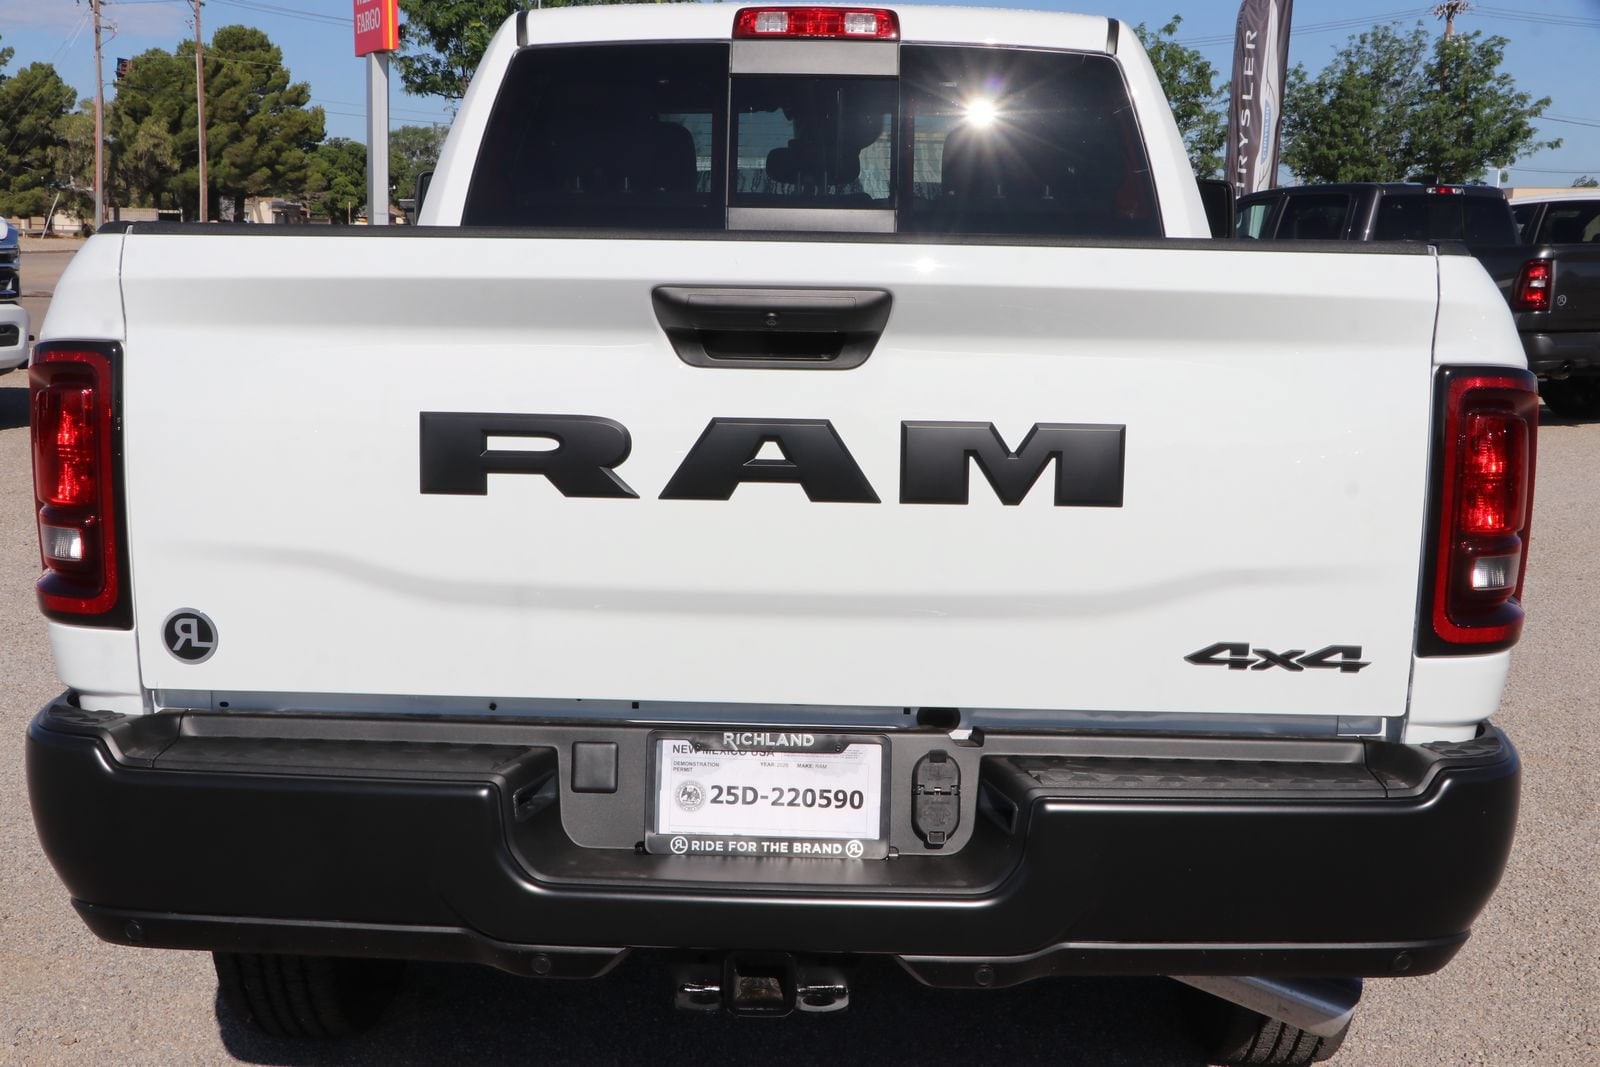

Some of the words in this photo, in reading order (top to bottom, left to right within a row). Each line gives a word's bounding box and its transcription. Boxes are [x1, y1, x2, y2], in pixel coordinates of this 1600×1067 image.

[356, 7, 381, 35] FARGO
[1235, 29, 1258, 199] HRYSLER
[419, 411, 1127, 508] RAM
[1184, 641, 1372, 673] 4x4
[723, 732, 815, 750] RICHLAND
[710, 784, 864, 810] 25D-220590
[691, 840, 724, 851] RIDE
[728, 841, 758, 852] FOR
[761, 842, 789, 853] THE
[793, 842, 842, 855] BRAND
